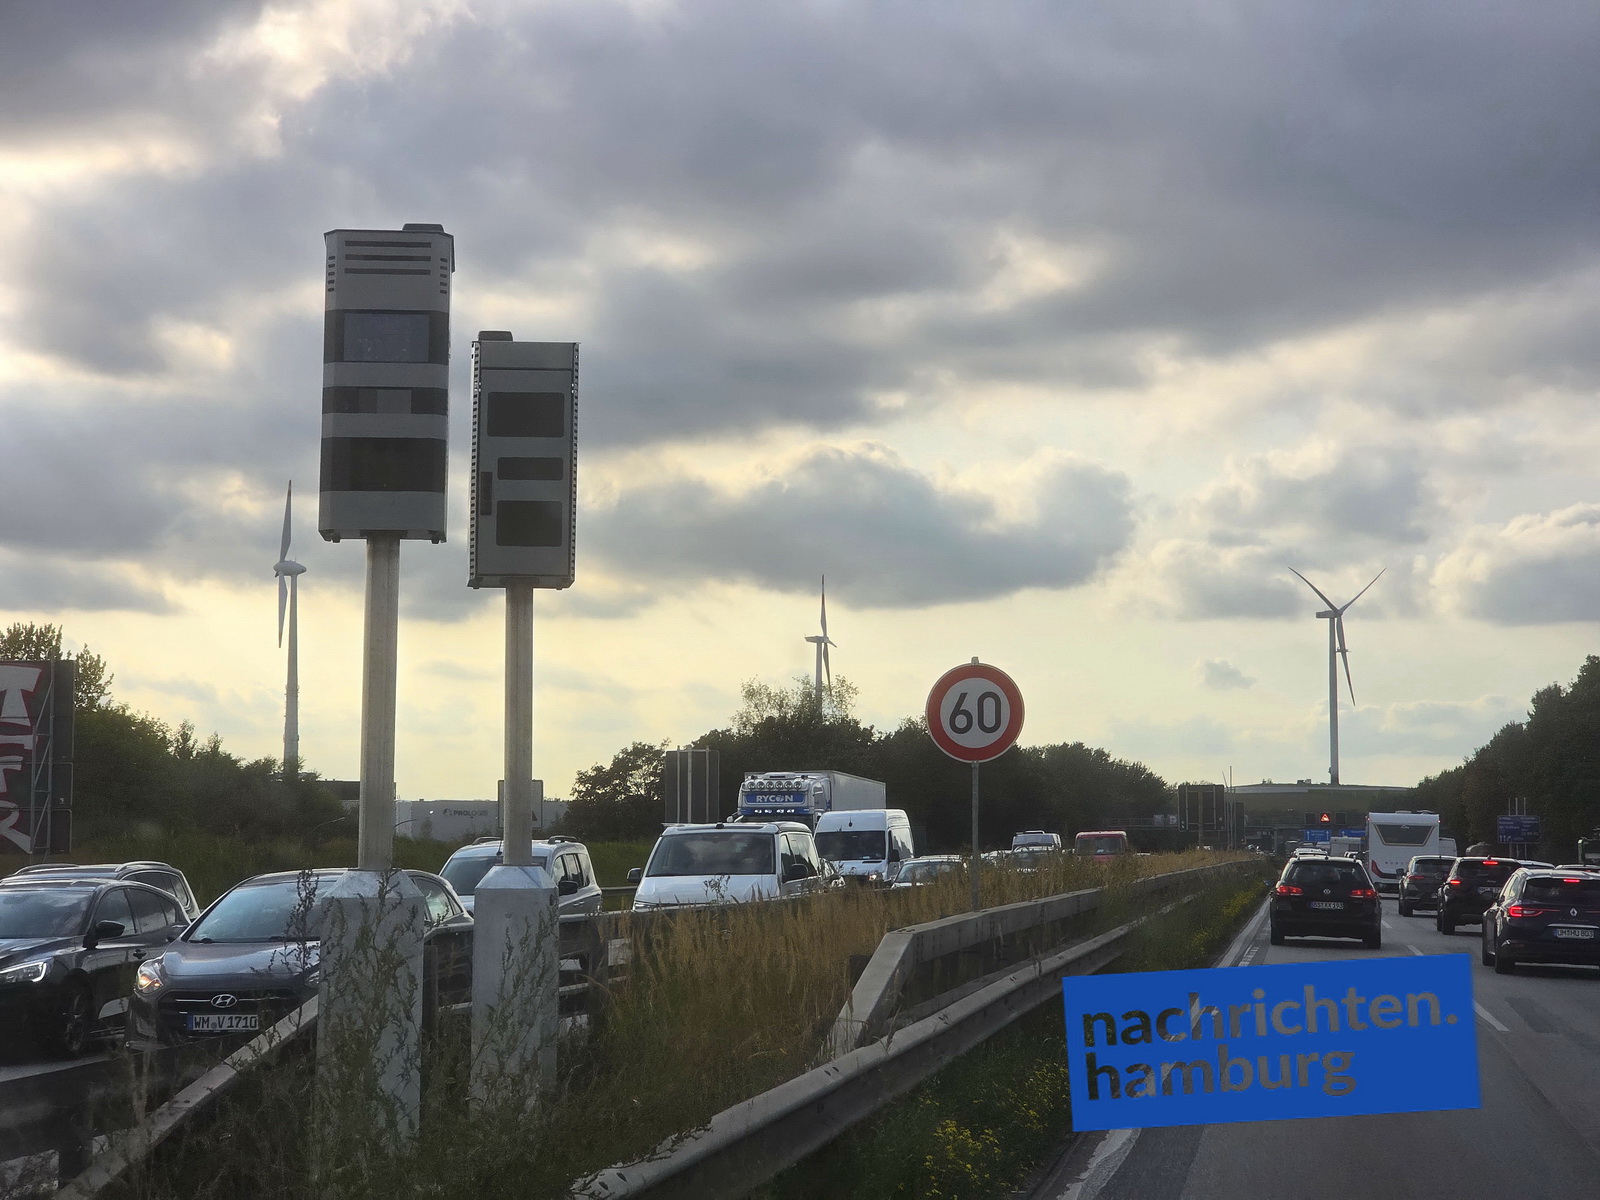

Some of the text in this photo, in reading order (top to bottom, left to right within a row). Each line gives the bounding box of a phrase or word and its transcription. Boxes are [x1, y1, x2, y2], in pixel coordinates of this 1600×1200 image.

[949, 691, 1002, 734] 60
[756, 794, 794, 803] RYCON
[194, 1016, 258, 1029] WM V 1710
